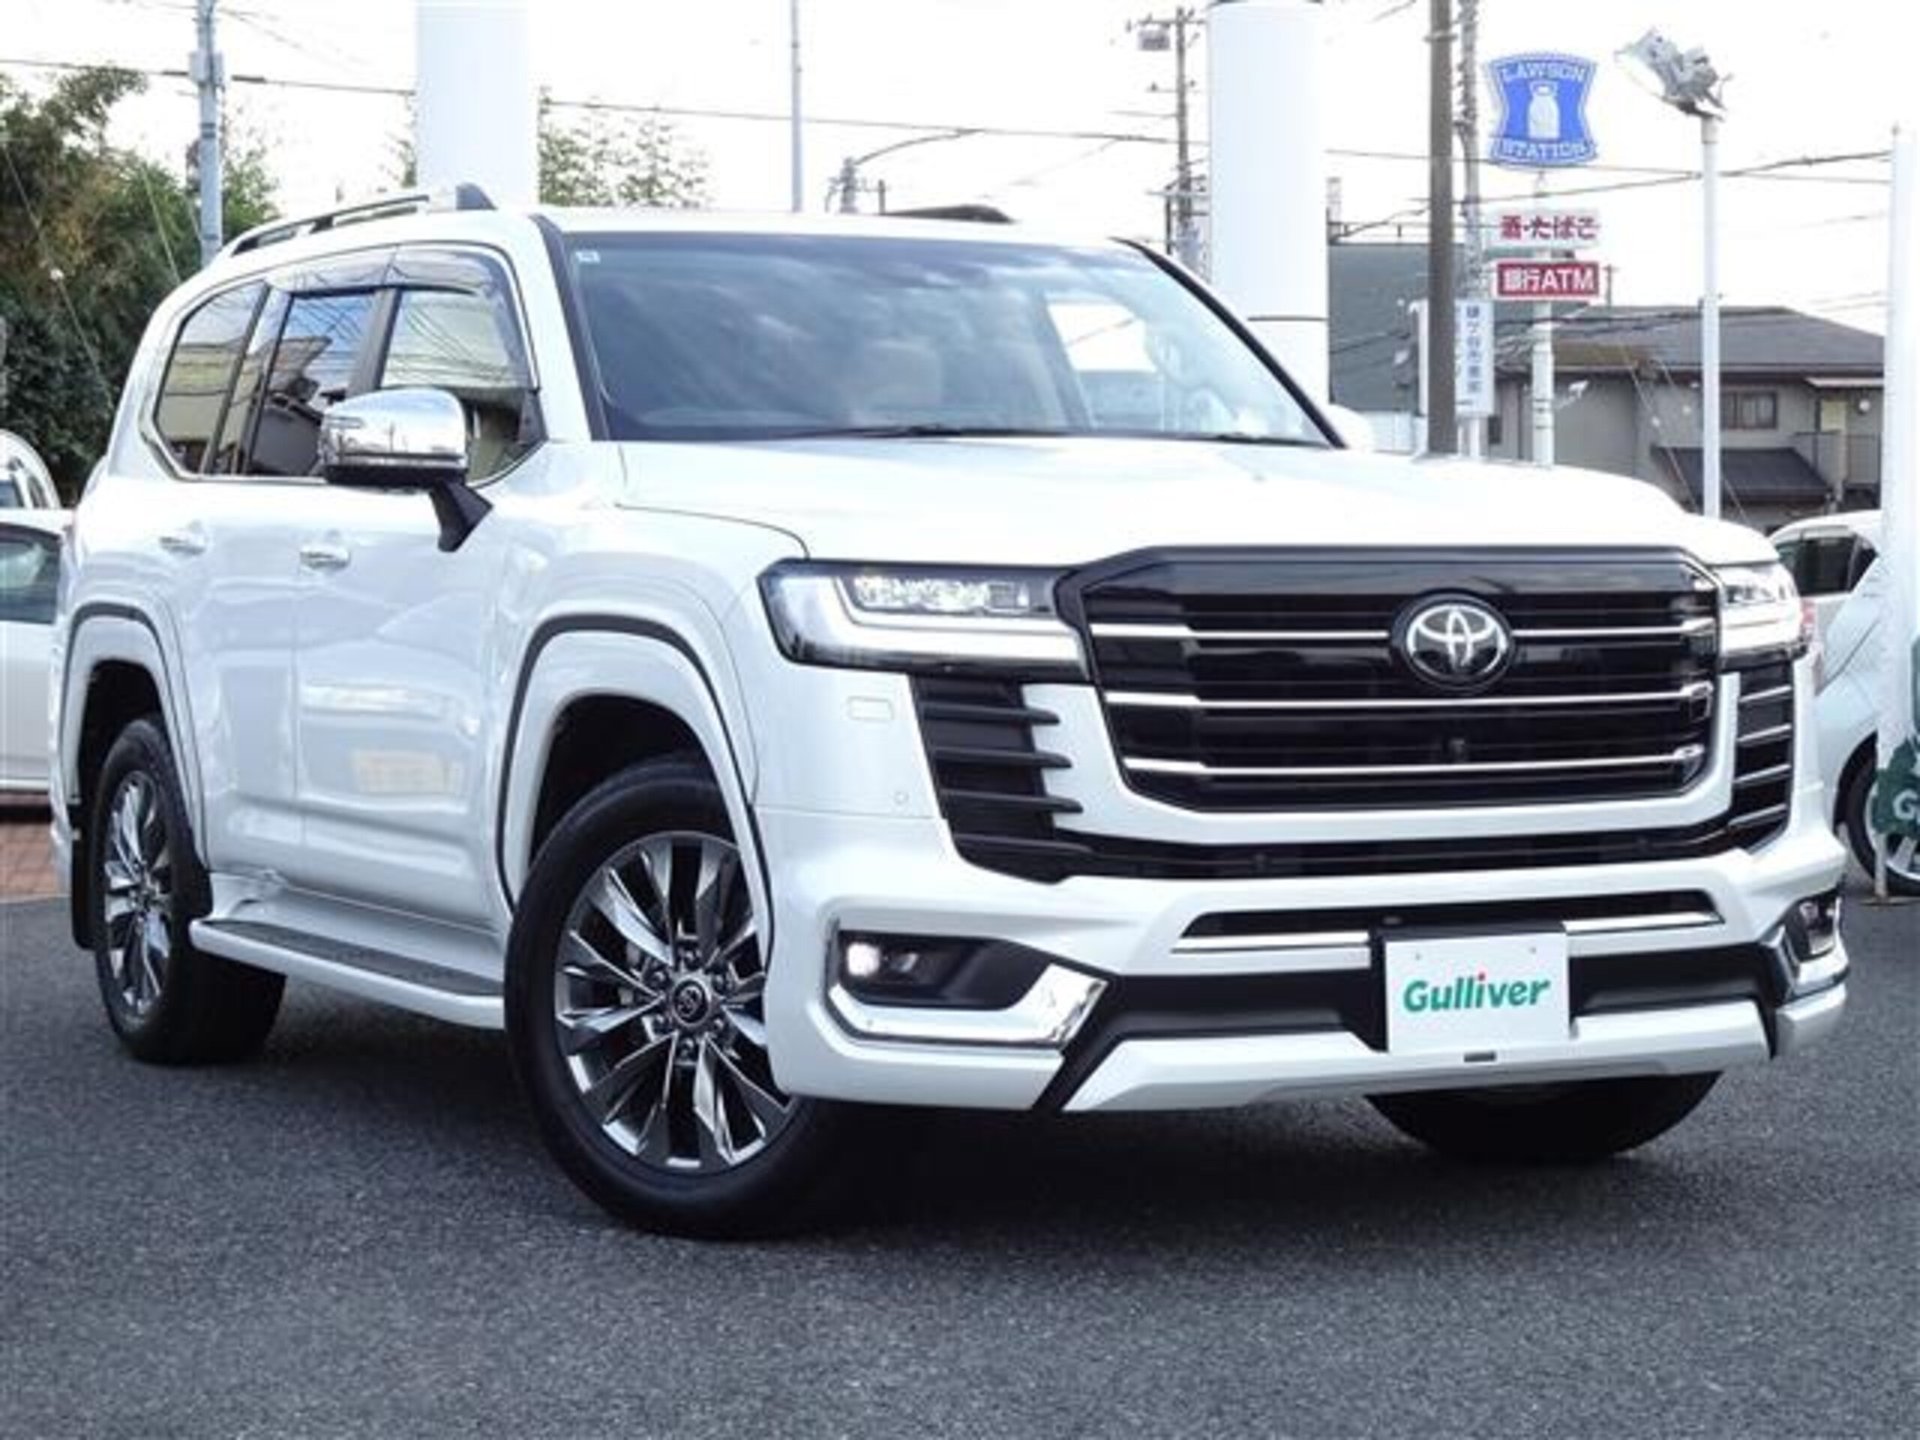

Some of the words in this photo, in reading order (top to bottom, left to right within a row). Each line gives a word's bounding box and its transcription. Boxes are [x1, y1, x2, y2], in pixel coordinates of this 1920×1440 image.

[1502, 60, 1586, 83] LAWSON
[1502, 266, 1595, 292] 銀行ATM
[1403, 972, 1551, 1012] Gulliver
